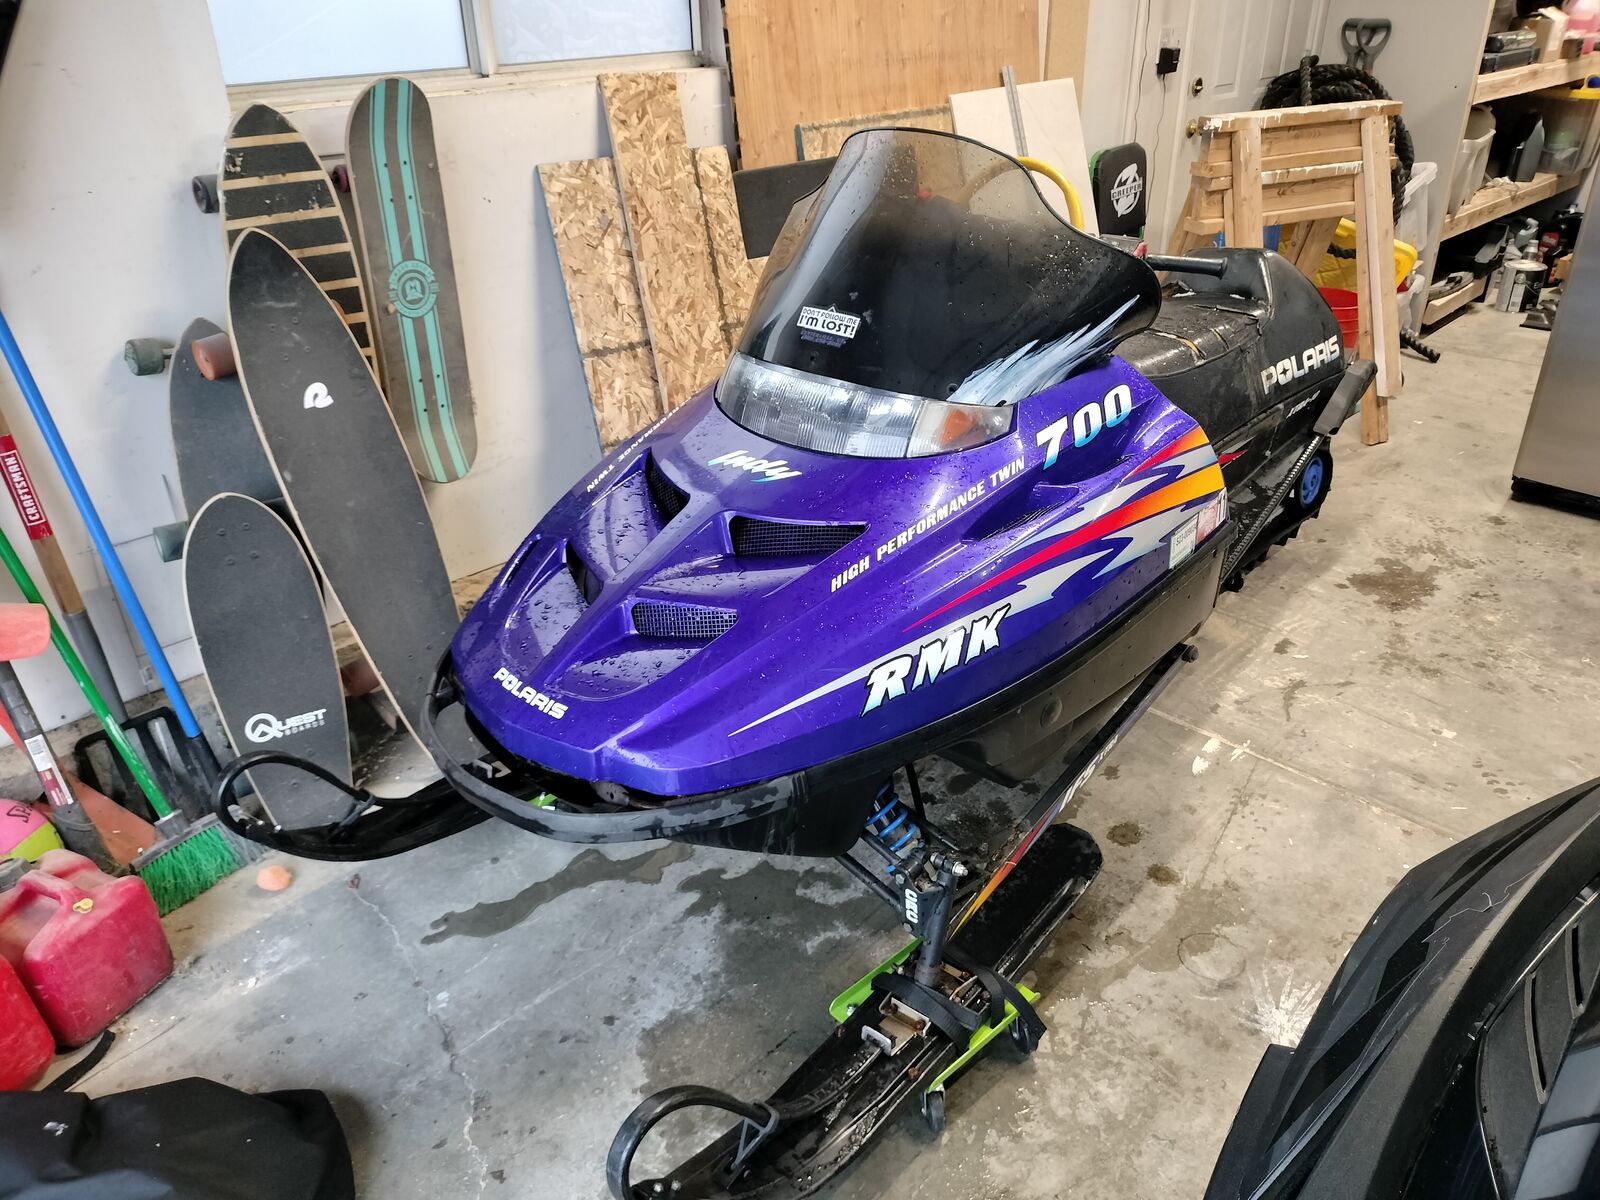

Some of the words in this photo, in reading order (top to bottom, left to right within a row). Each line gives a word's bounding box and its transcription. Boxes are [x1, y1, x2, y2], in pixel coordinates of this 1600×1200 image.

[1111, 182, 1142, 199] CREEPER
[799, 314, 819, 328] I'M
[821, 319, 855, 335] LOST!
[802, 308, 820, 317] DON'T
[820, 311, 847, 323] FOLLOW
[846, 317, 858, 326] ME
[1260, 334, 1340, 395] POLARIS
[1036, 383, 1133, 471] 700
[586, 463, 616, 493] TWIN
[707, 449, 803, 483] Indy
[4, 455, 41, 522] CRAFTSMAN
[830, 555, 870, 593] HIGH
[876, 480, 986, 562] PERFORMANCE
[989, 456, 1025, 487] TWIN
[860, 602, 1012, 718] RMK
[492, 667, 569, 720] POLARIS
[244, 708, 327, 743] QUEST
[284, 719, 325, 736] BOARDS
